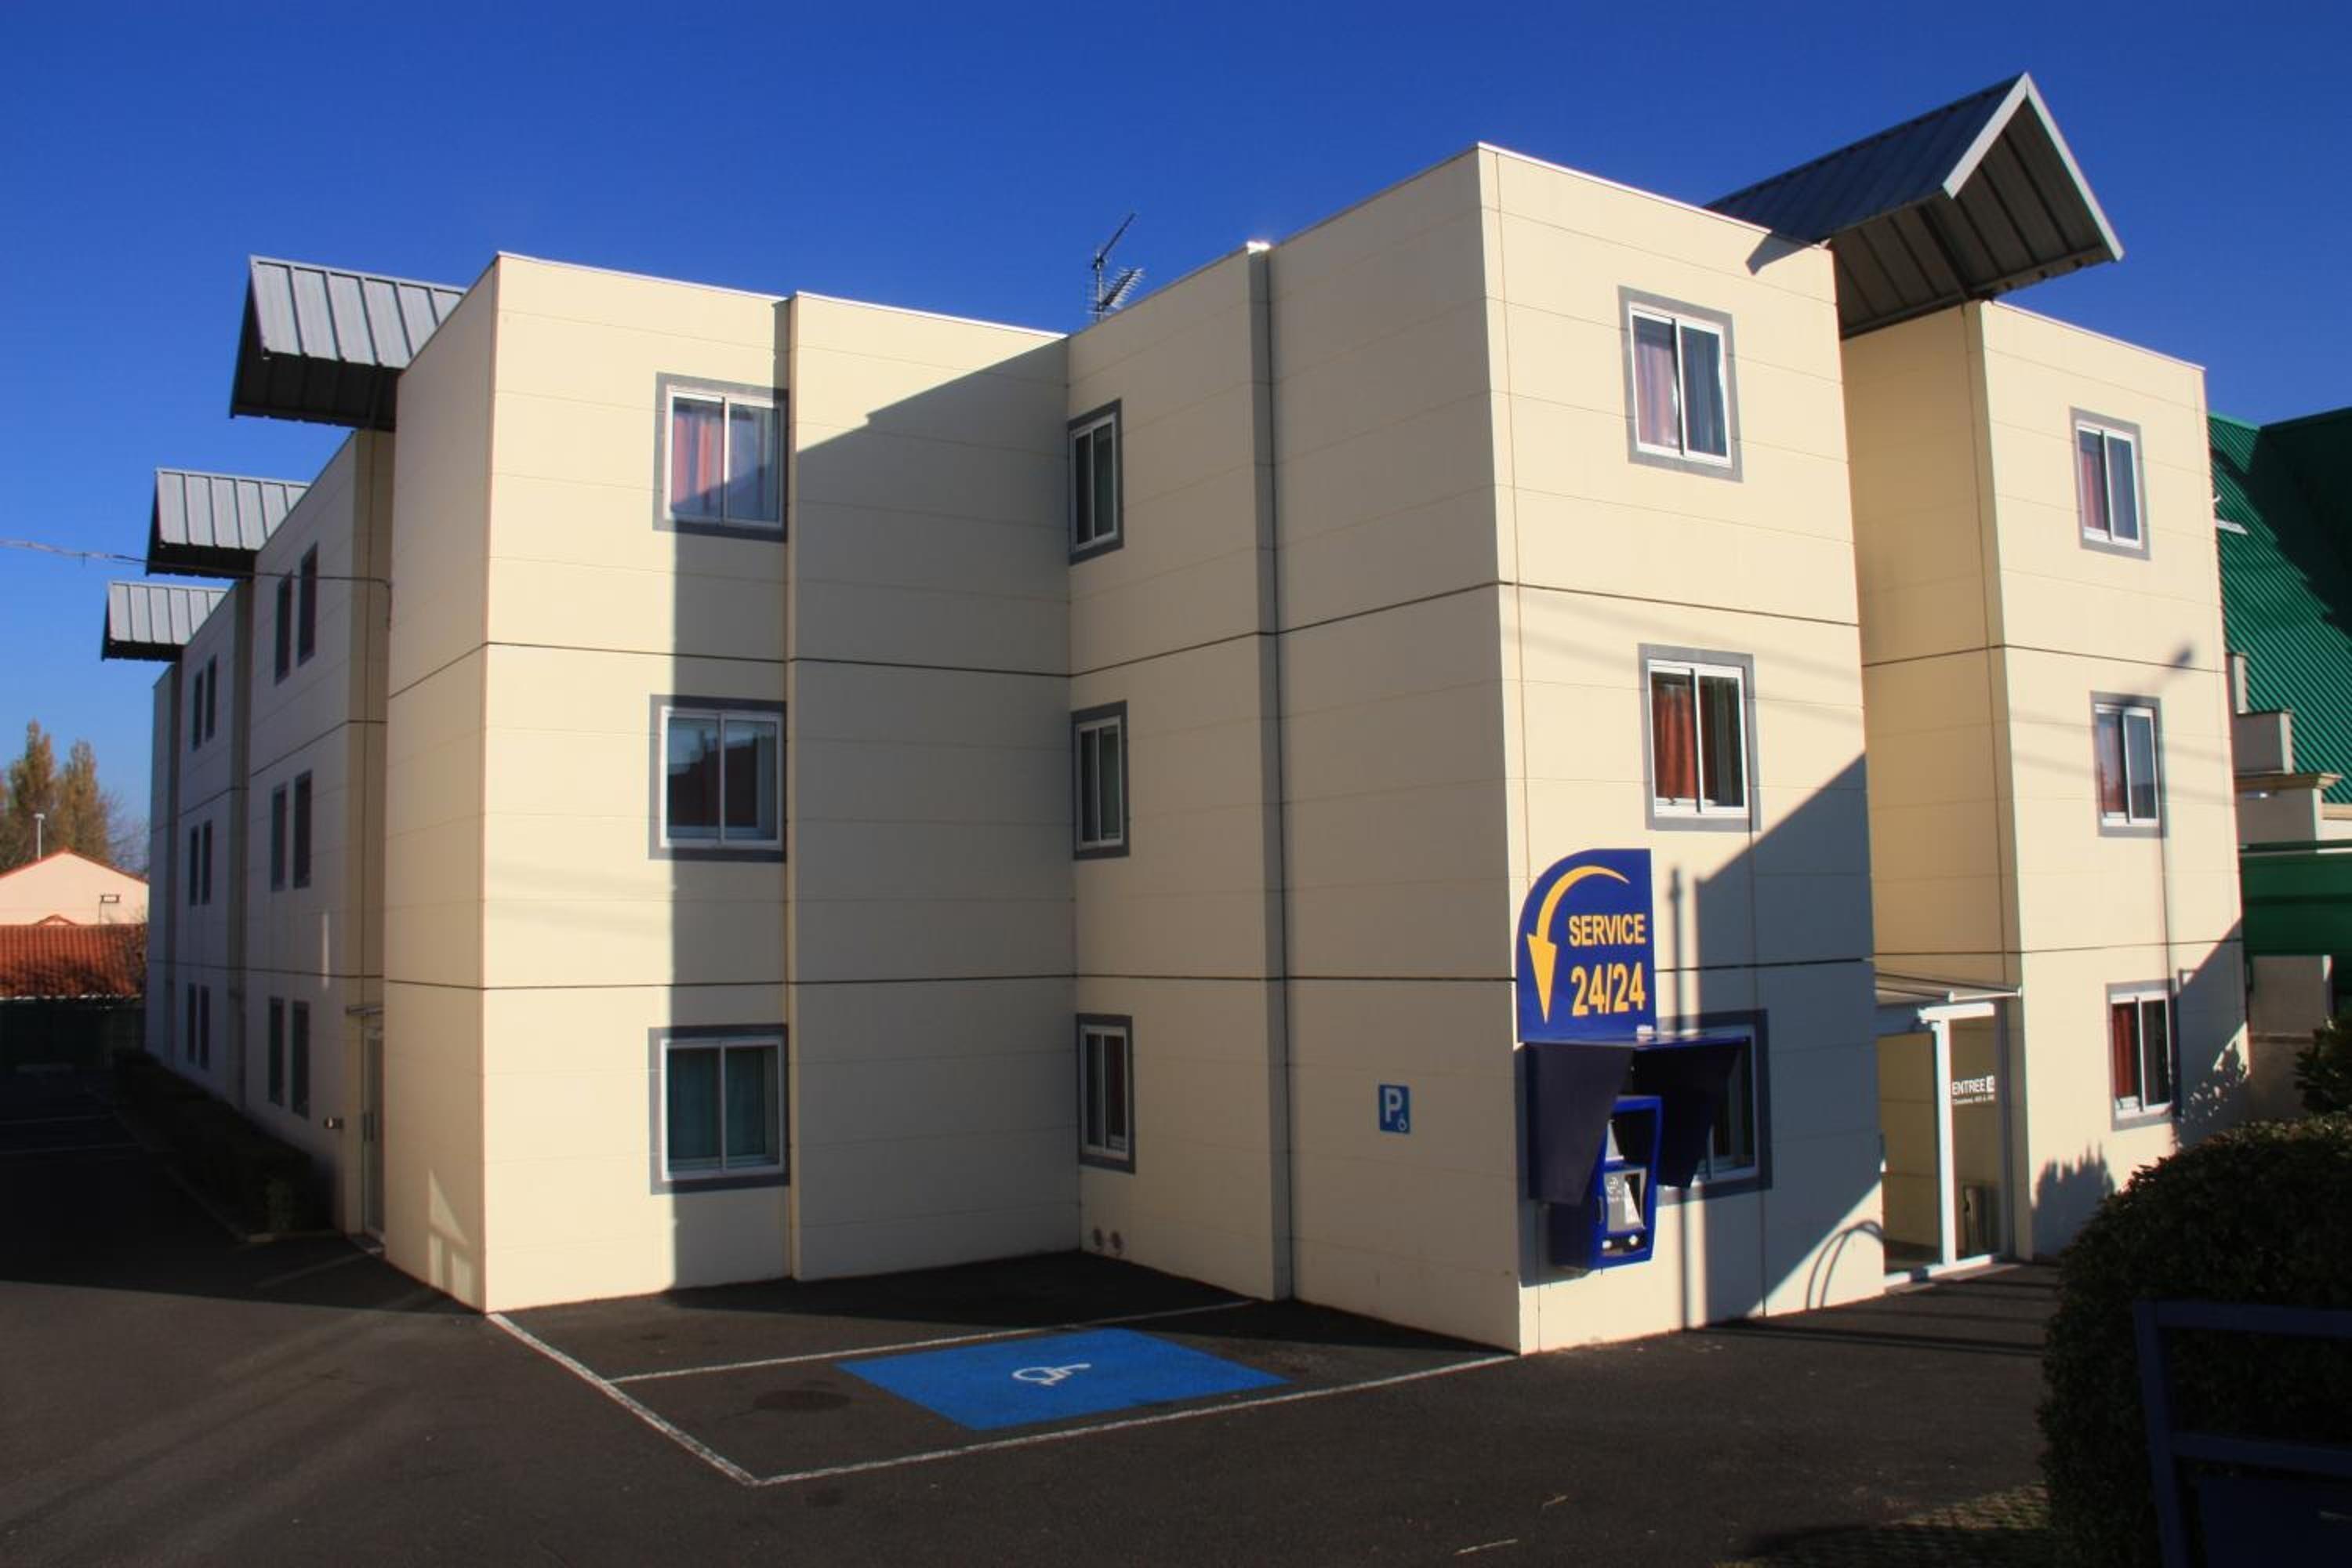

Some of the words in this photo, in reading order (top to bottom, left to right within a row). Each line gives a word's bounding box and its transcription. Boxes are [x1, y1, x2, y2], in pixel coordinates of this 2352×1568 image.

[1569, 913, 1646, 946] SERVICE
[1571, 961, 1646, 1016] 24/24
[1951, 1078, 1985, 1095] ENTREE
[1385, 1087, 1403, 1122] P
